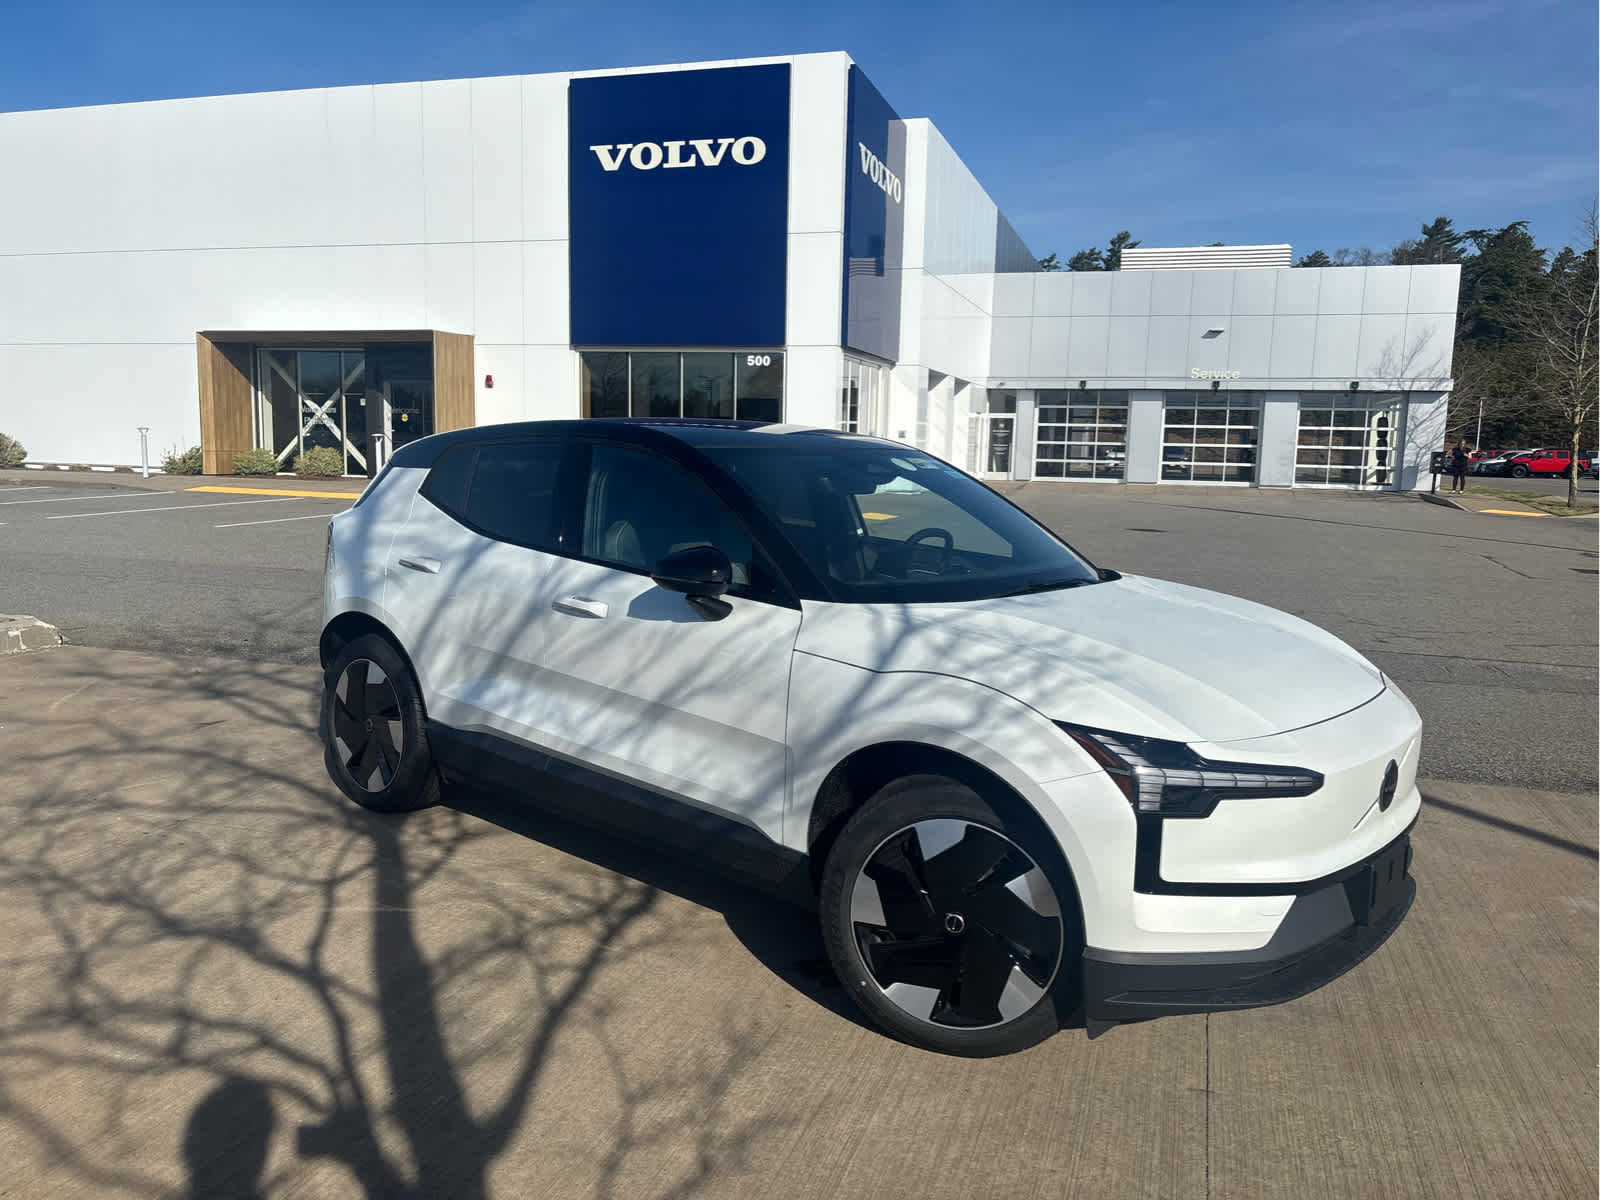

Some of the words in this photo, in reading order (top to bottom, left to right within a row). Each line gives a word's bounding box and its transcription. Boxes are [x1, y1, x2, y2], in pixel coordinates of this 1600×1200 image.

[590, 136, 766, 172] VOLVO
[859, 141, 902, 205] VOLVO
[747, 355, 771, 367] 500
[1191, 367, 1241, 380] Service
